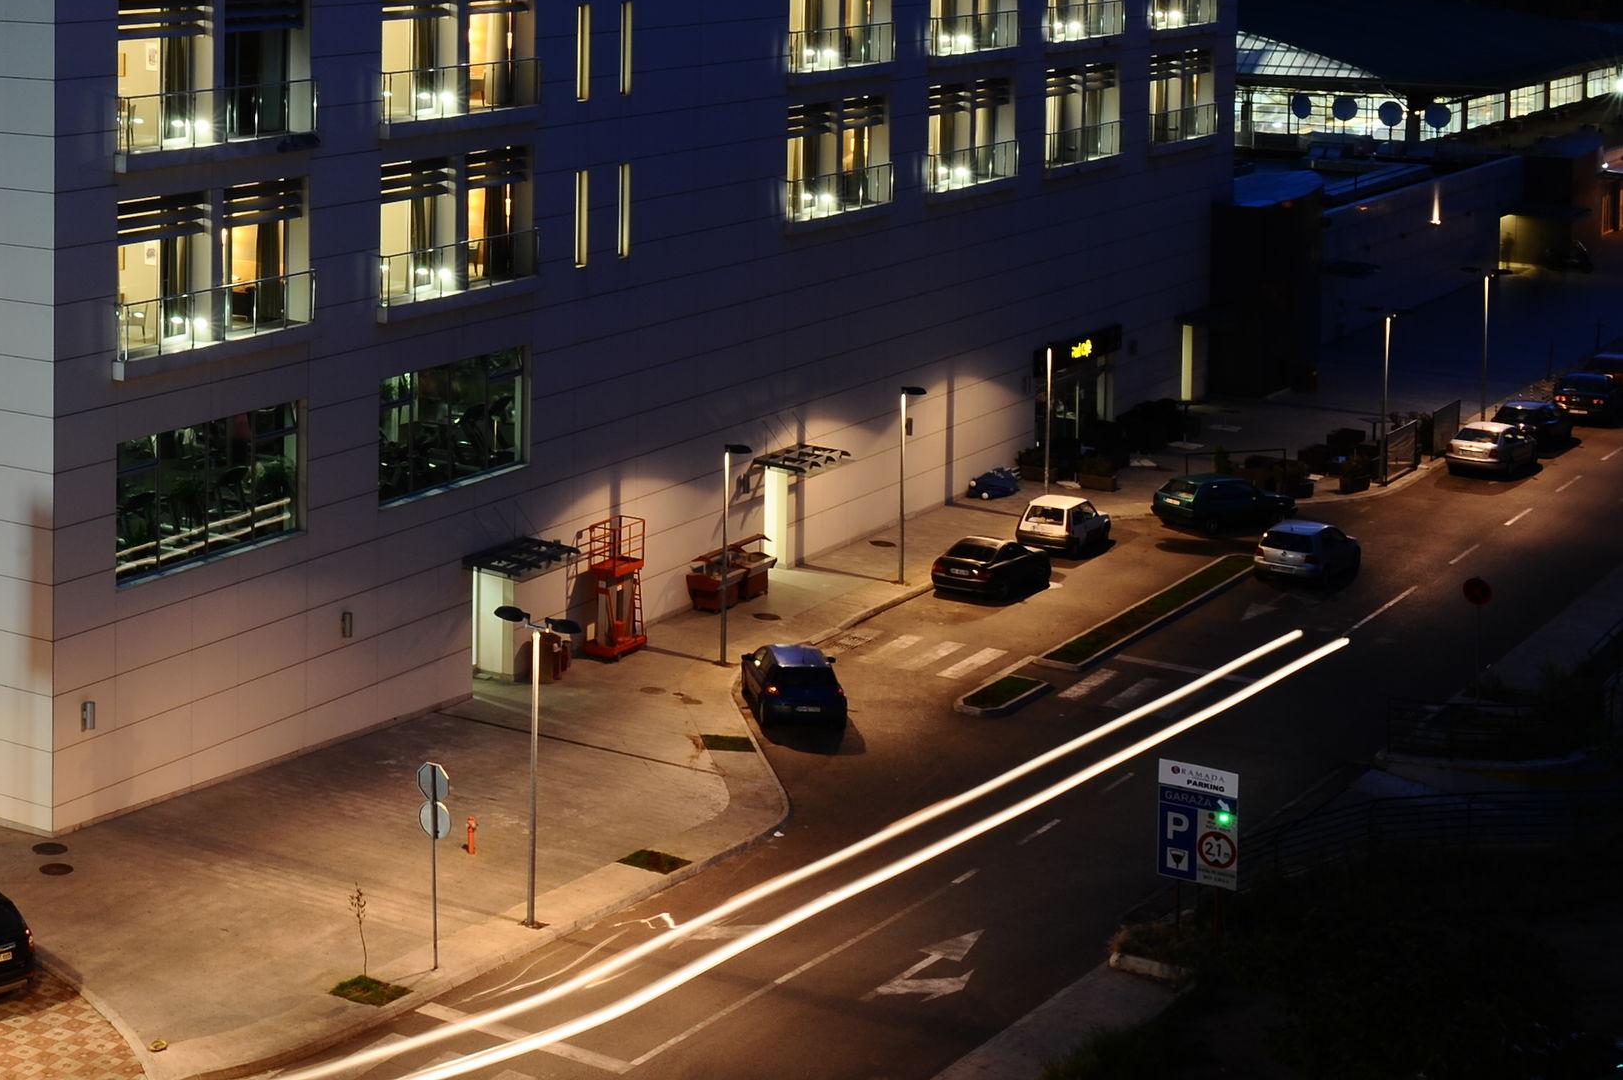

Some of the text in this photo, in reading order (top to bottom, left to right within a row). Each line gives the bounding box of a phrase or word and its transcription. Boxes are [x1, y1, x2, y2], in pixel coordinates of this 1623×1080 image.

[1181, 768, 1225, 783] RAMADA
[1186, 779, 1225, 793] PARKING
[1166, 810, 1190, 840] P
